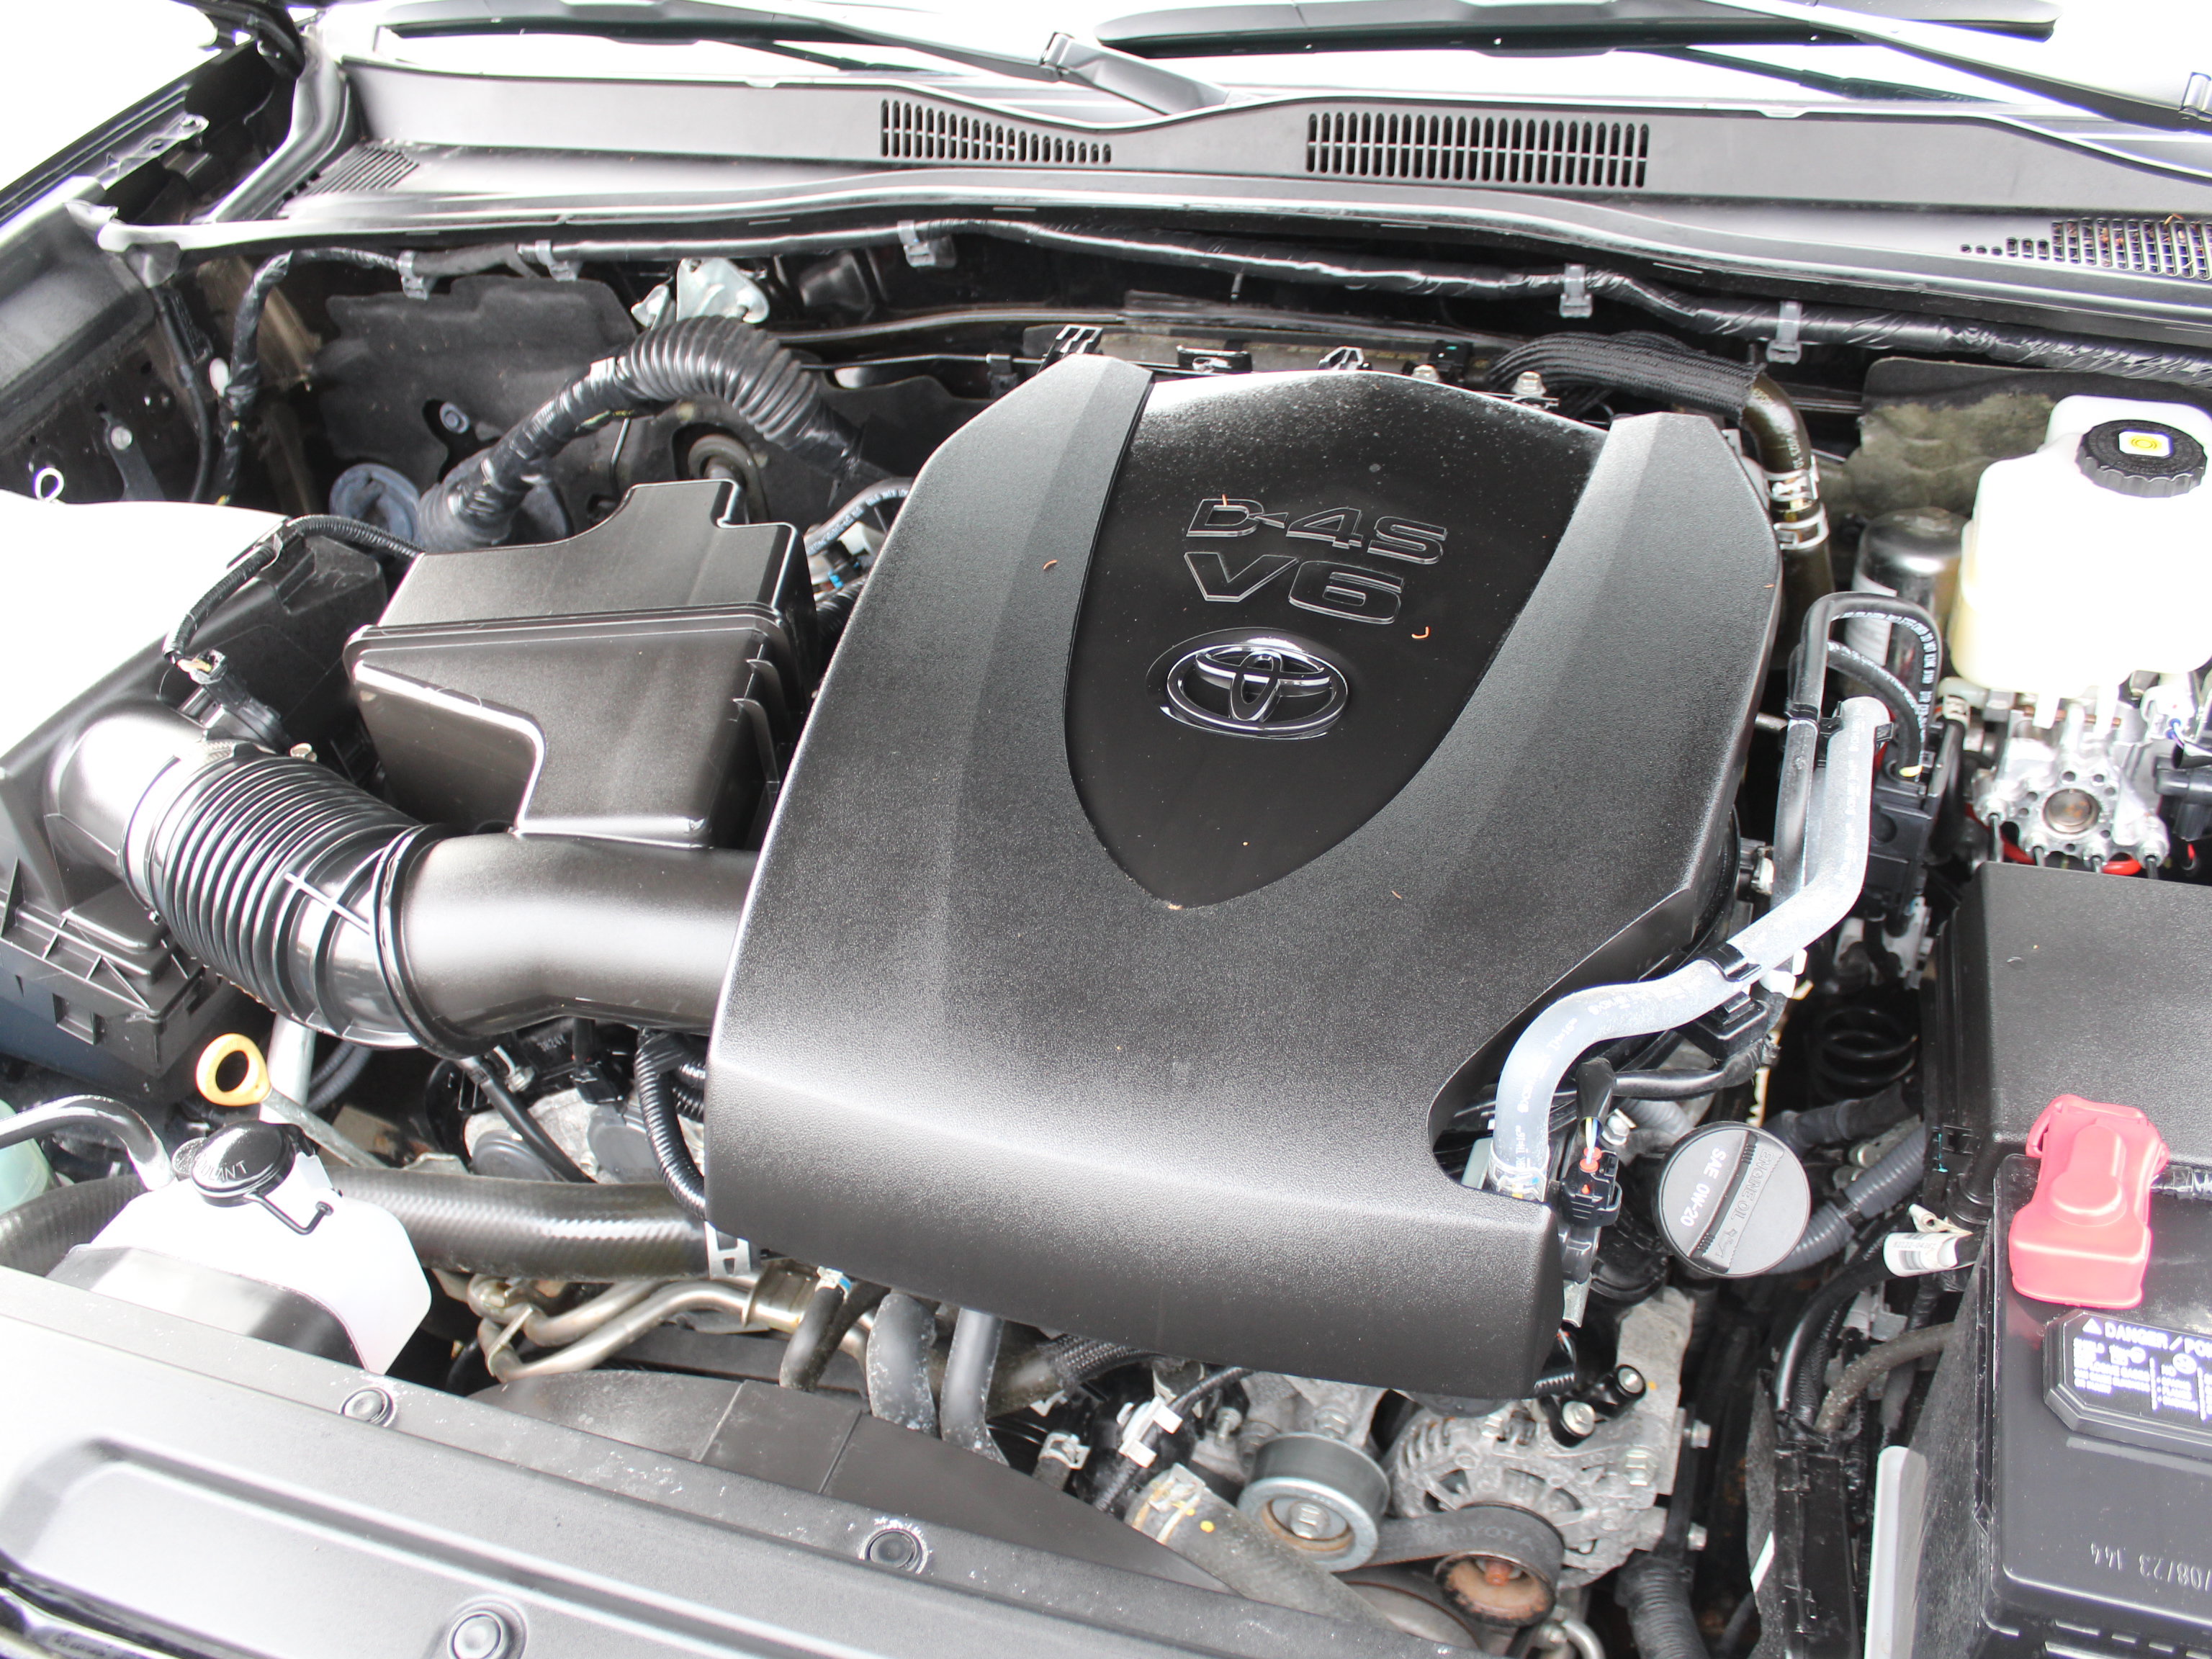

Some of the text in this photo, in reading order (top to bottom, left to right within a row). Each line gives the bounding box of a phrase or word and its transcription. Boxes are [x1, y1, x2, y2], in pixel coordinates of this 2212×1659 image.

[1186, 498, 1448, 565] D-4S
[1184, 552, 1405, 625] V6
[1680, 1147, 1727, 1228] SAE 0W-20
[1730, 1148, 1775, 1221] ENGINE OIL
[2105, 1322, 2168, 1349] DANGER
[1446, 1525, 1535, 1552] OYOTA
